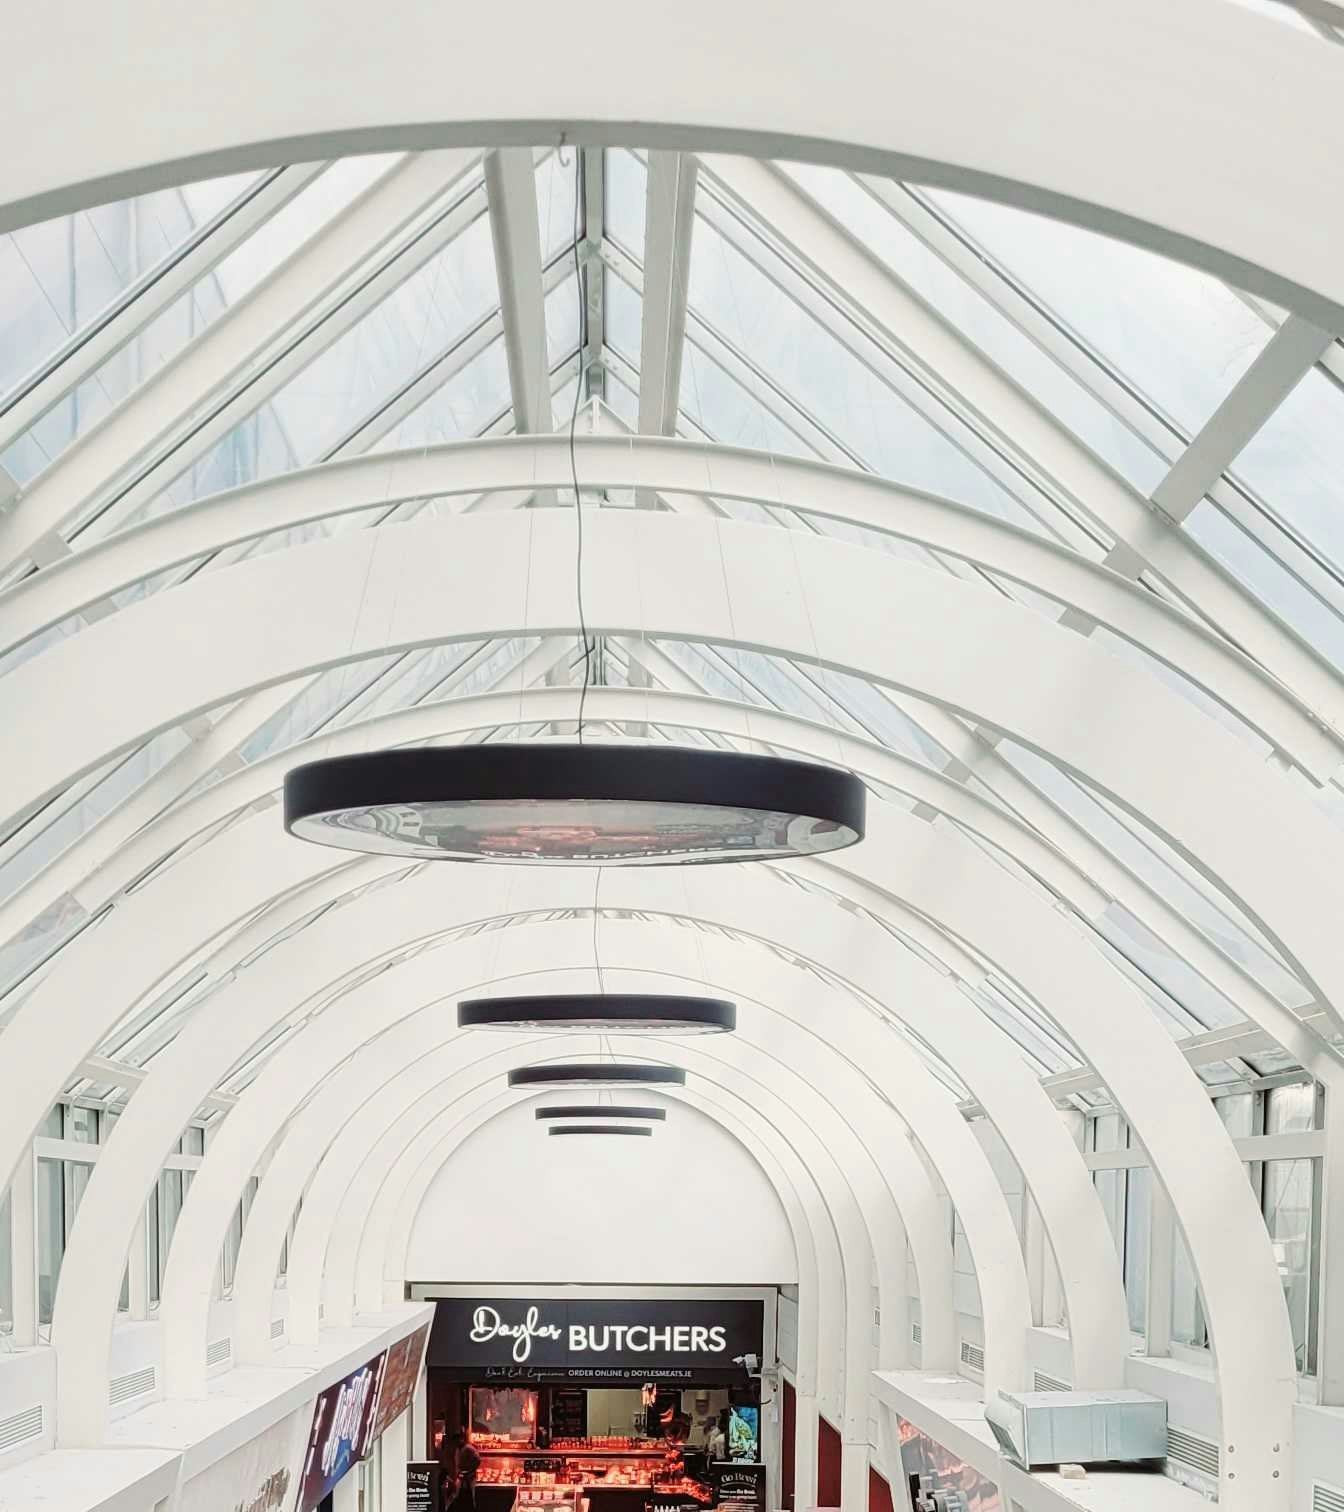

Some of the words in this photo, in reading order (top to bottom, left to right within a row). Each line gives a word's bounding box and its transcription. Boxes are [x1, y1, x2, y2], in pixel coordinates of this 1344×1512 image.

[469, 1305, 562, 1362] Doyles
[568, 1325, 727, 1351] BUTCHERS
[568, 1369, 594, 1377] ORDER
[594, 1369, 623, 1377] ONLINE
